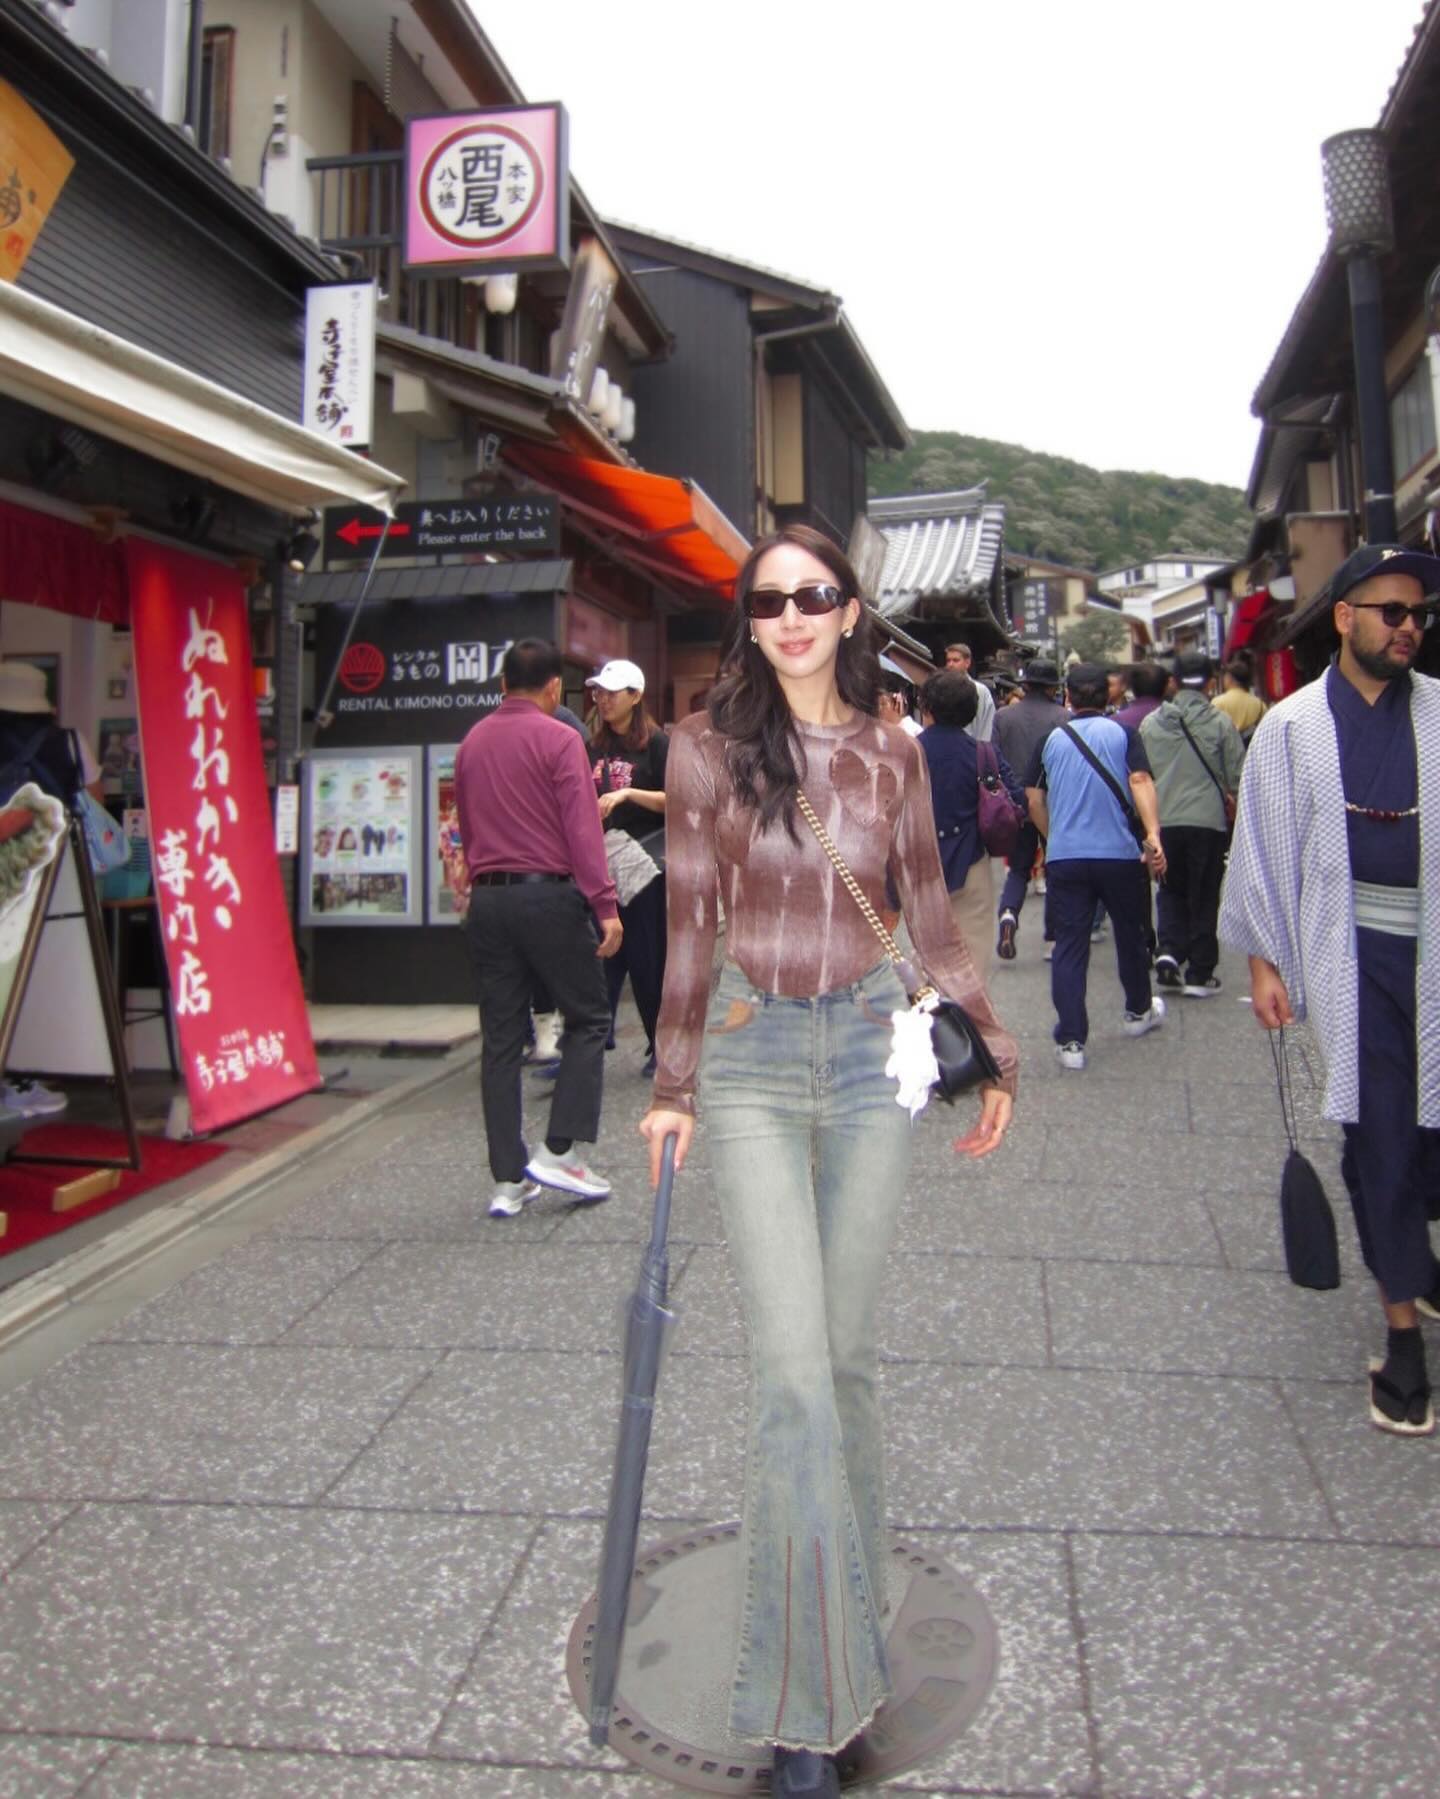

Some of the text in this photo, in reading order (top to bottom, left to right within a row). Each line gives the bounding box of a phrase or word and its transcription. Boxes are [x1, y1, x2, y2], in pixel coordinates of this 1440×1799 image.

[454, 143, 506, 228] 西尾
[420, 505, 550, 526] 奥へお入りください
[418, 526, 547, 546] Please enter the back
[392, 651, 440, 663] レンタル
[392, 663, 441, 681] きもの
[338, 697, 392, 713] RENTAL
[395, 694, 453, 711] KIMONO
[157, 828, 212, 1016] 専門店
